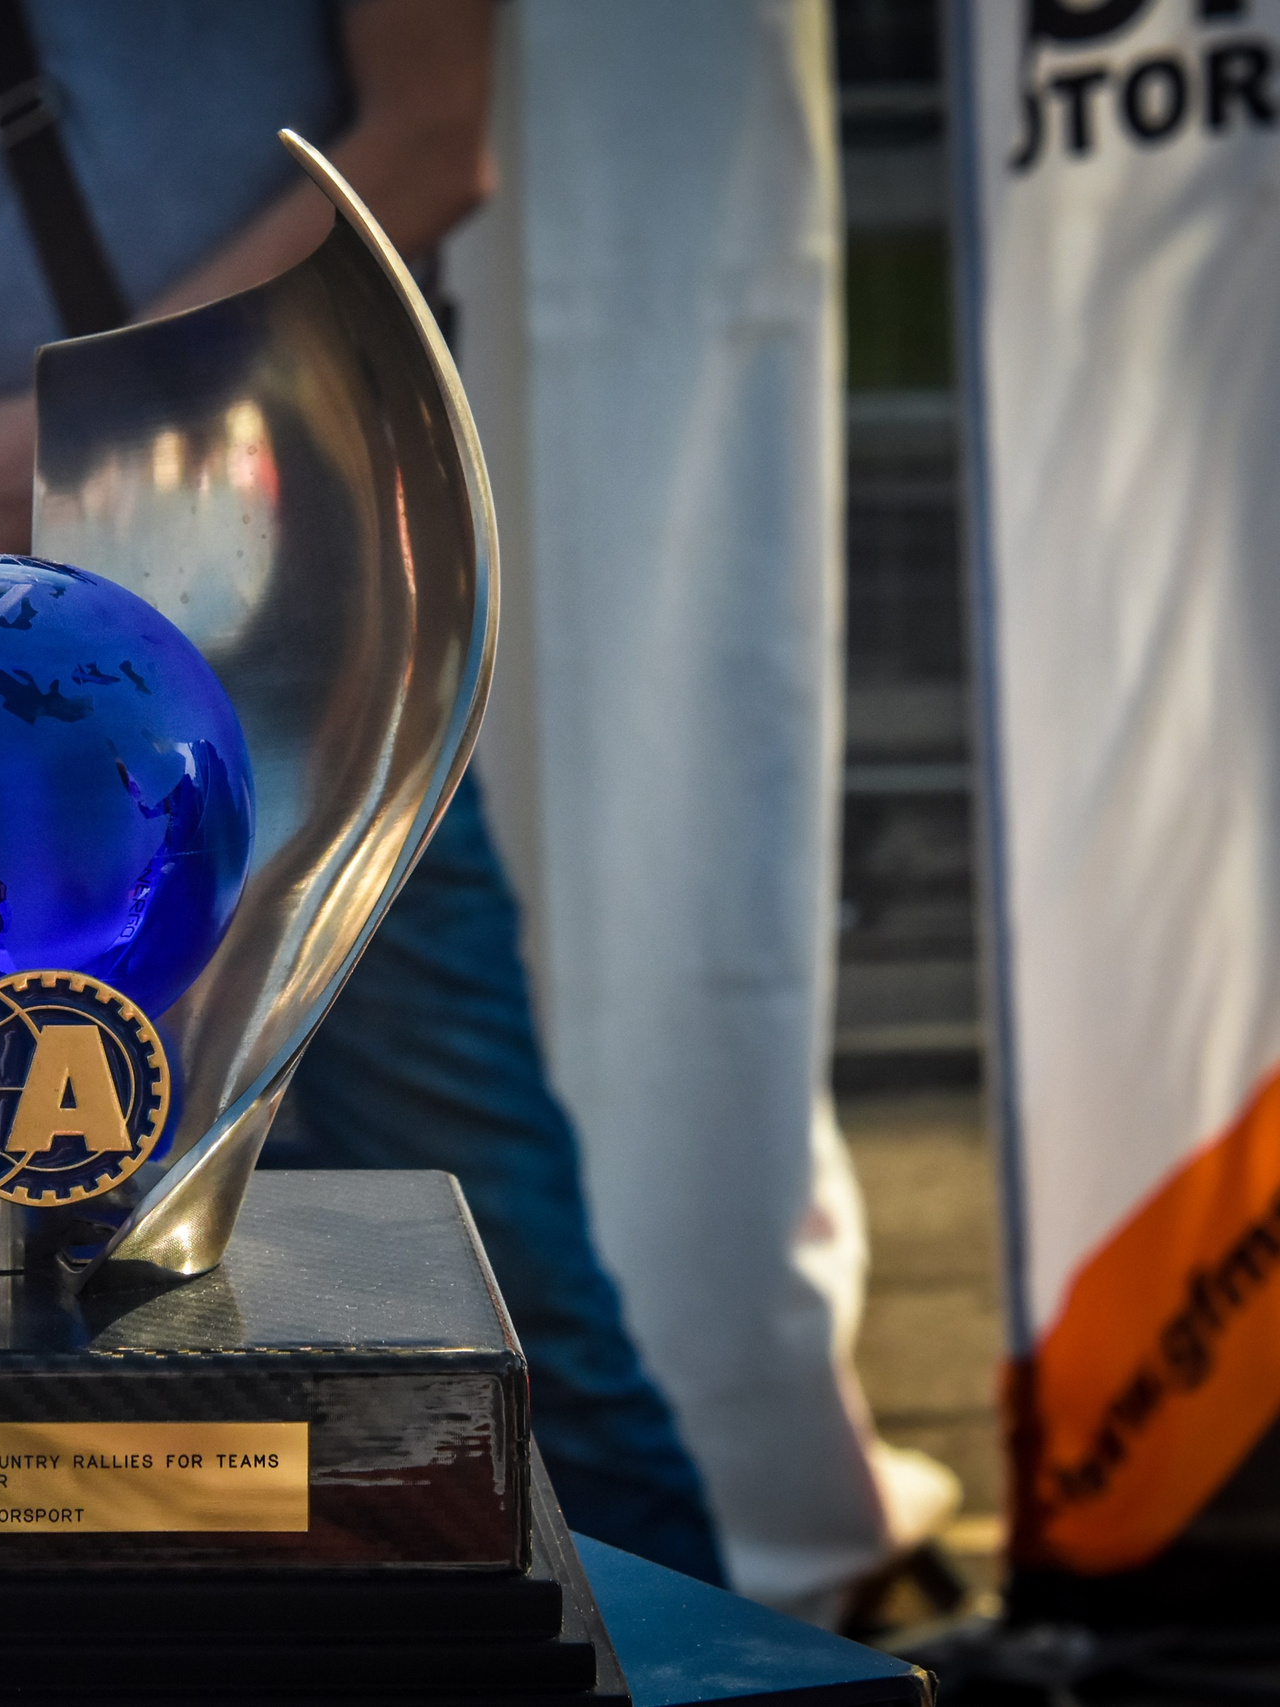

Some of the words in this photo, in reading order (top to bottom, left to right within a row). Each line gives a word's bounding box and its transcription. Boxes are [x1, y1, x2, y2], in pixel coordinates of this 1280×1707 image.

[73, 1454, 154, 1469] RALLIES
[166, 1454, 204, 1469] FOR
[216, 1454, 280, 1469] TEAMS
